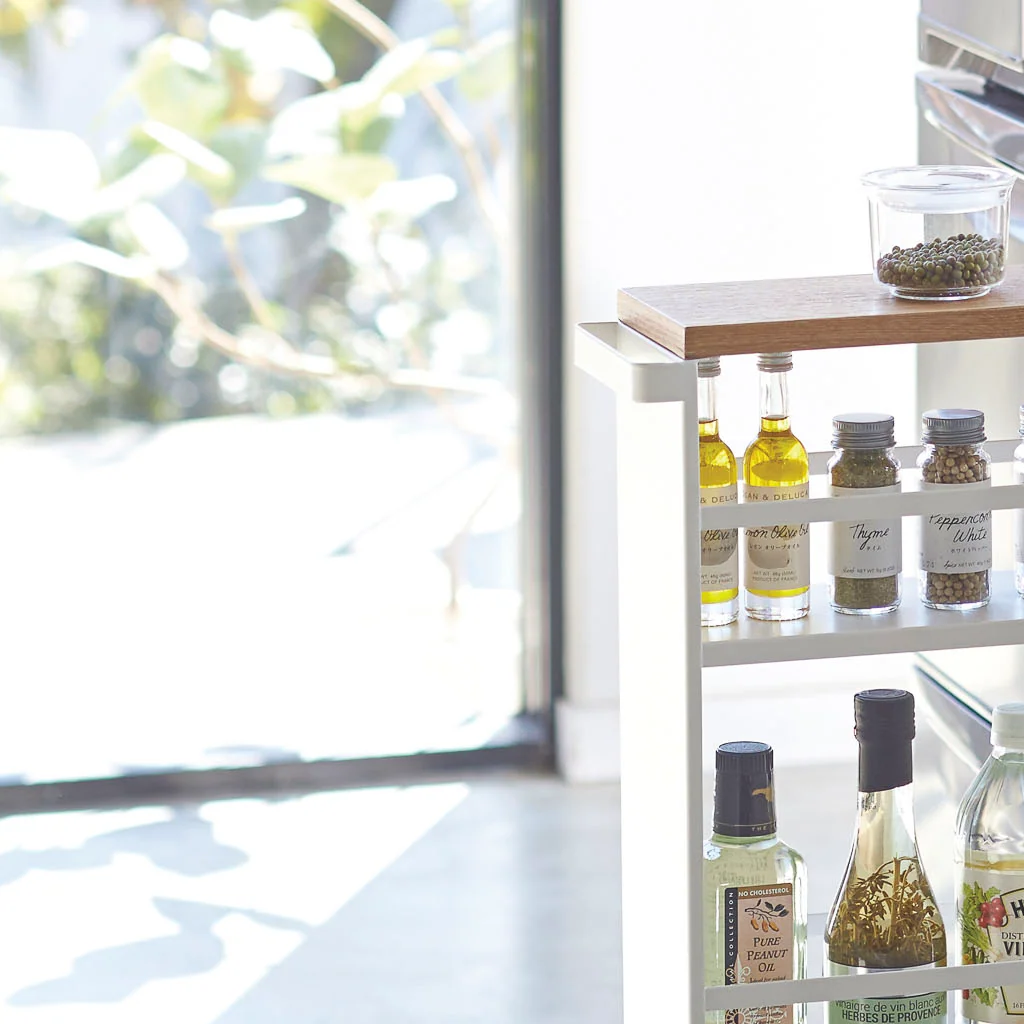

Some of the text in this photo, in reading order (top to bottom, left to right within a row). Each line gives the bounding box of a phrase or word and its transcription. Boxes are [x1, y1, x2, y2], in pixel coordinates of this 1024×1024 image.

[770, 525, 798, 539] Olive
[849, 523, 890, 551] Thyme
[953, 526, 988, 543] White
[749, 887, 790, 896] CHOLESTEROL
[873, 1002, 887, 1012] de
[889, 1001, 906, 1012] vin
[909, 999, 934, 1010] blanc
[841, 1004, 941, 1024] HERBES DE PROVENCE
